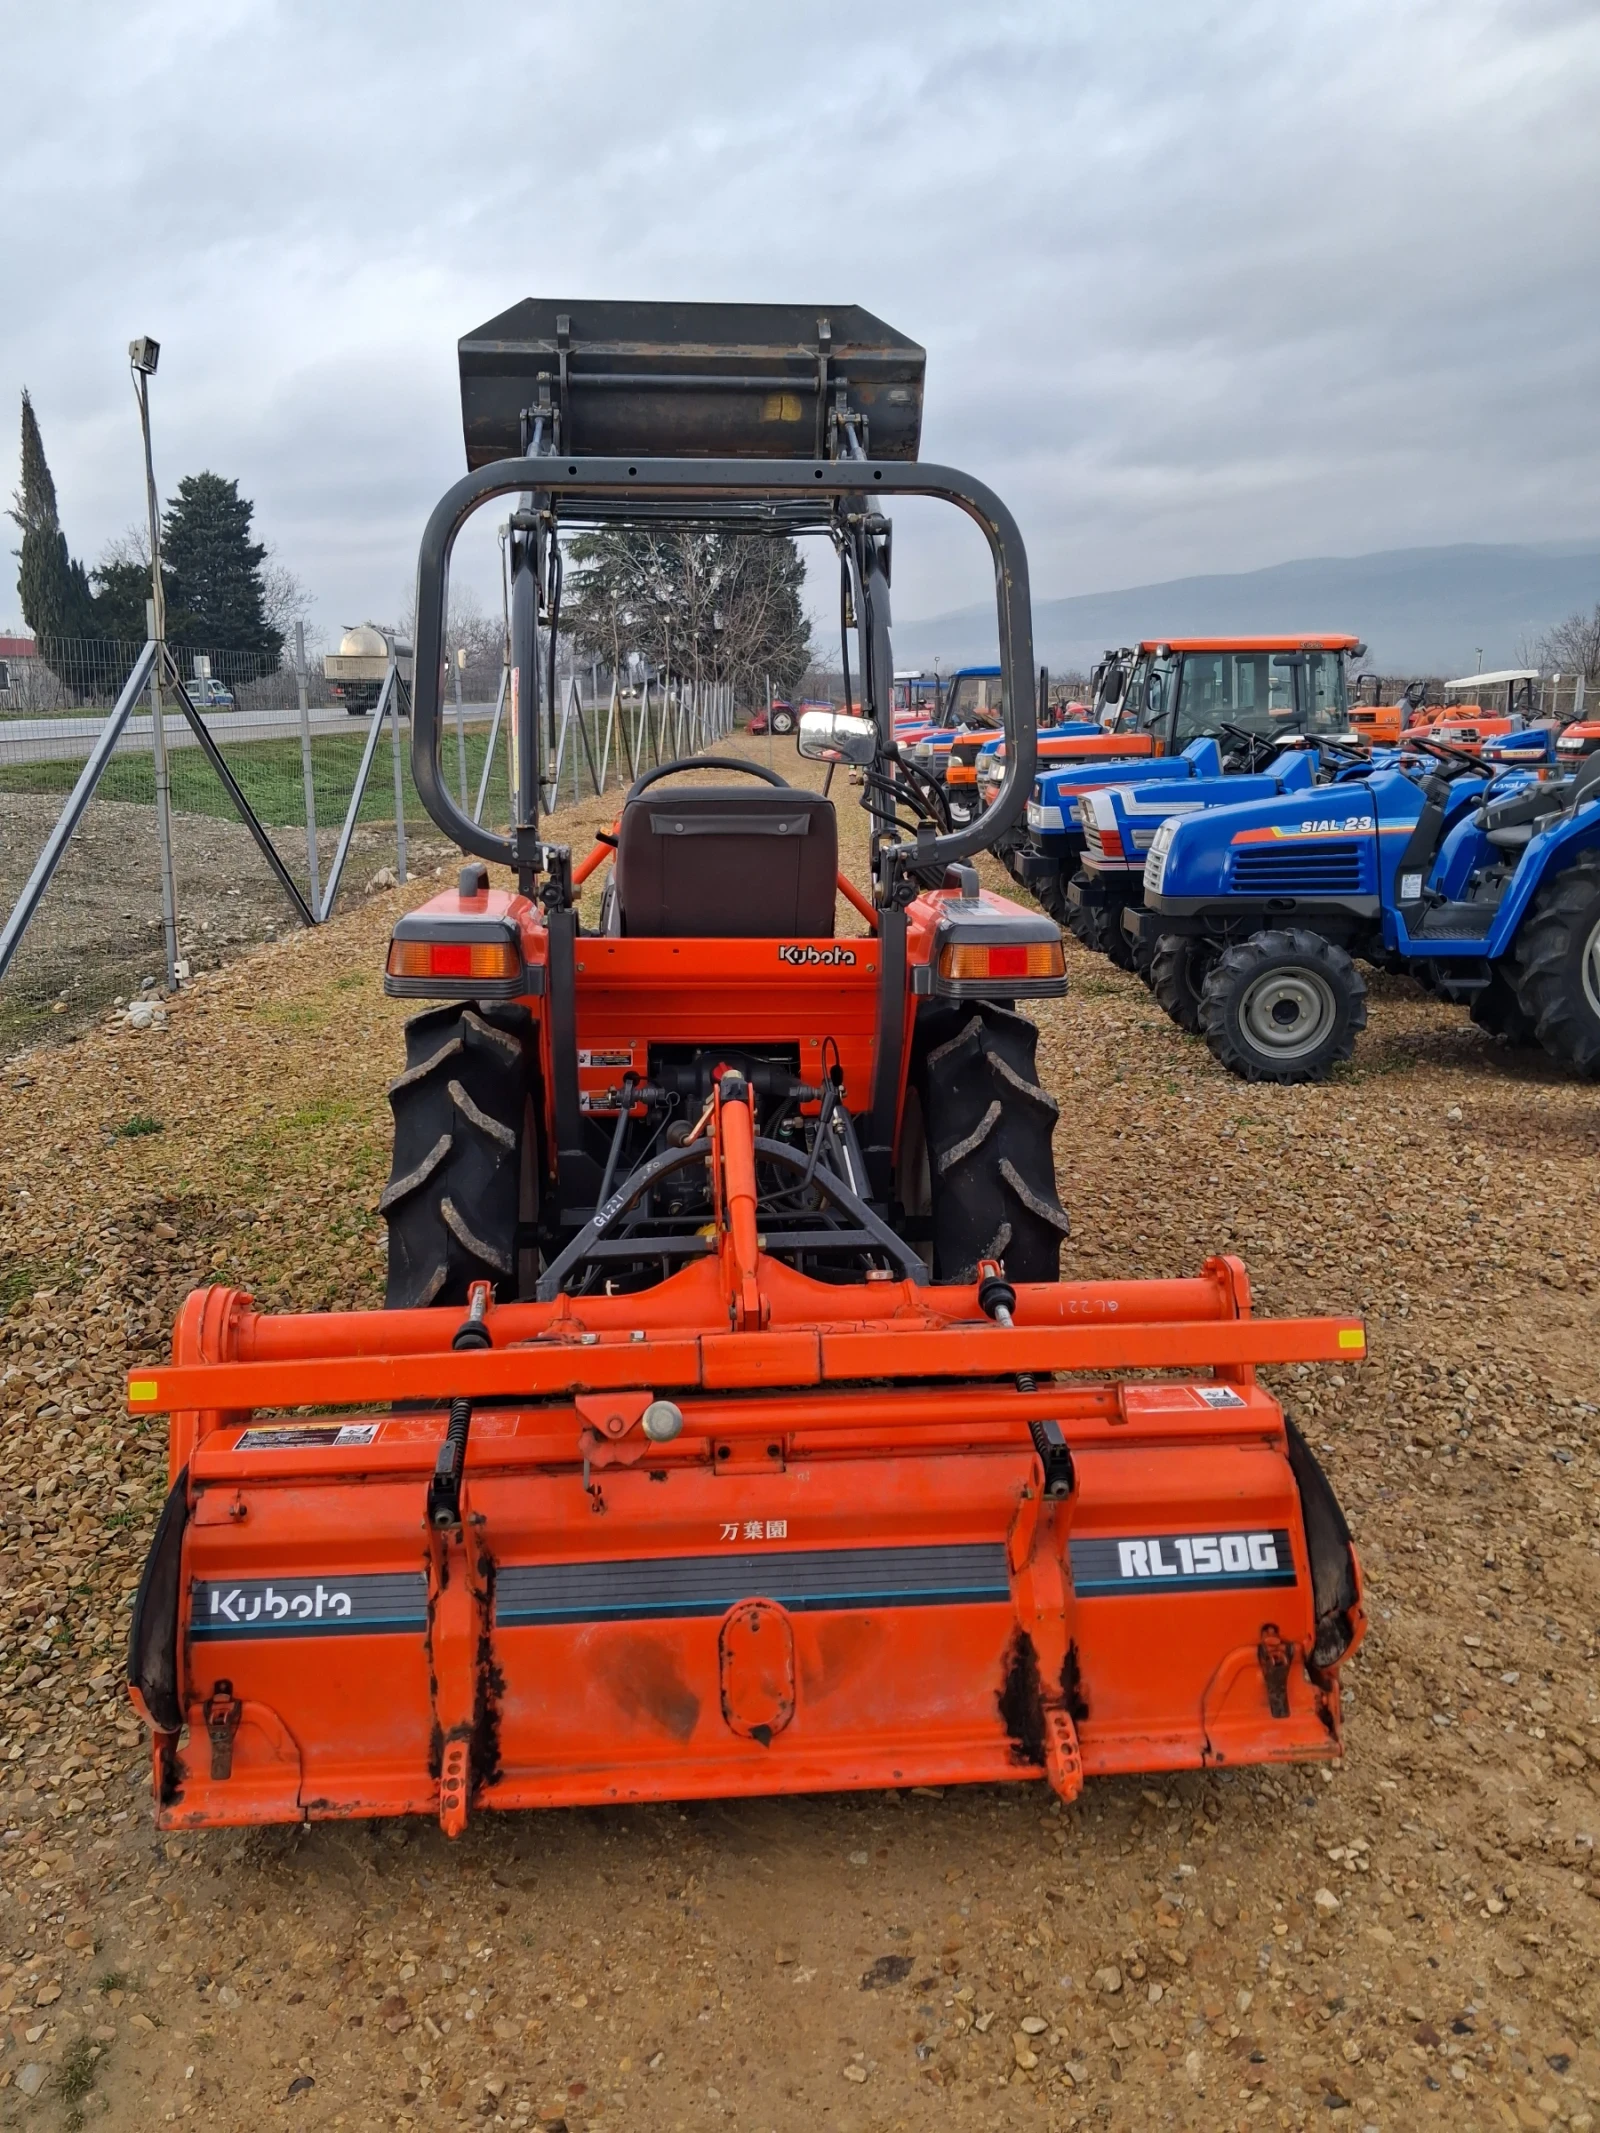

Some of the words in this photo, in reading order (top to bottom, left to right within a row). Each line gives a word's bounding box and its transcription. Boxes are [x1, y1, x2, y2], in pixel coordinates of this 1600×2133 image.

[1300, 819, 1340, 833] SIAL
[1343, 815, 1373, 832] 23
[779, 945, 856, 965] Kubota
[719, 1519, 788, 1541] 万葉園
[1117, 1534, 1279, 1578] RL150G
[210, 1584, 352, 1622] Kubota
